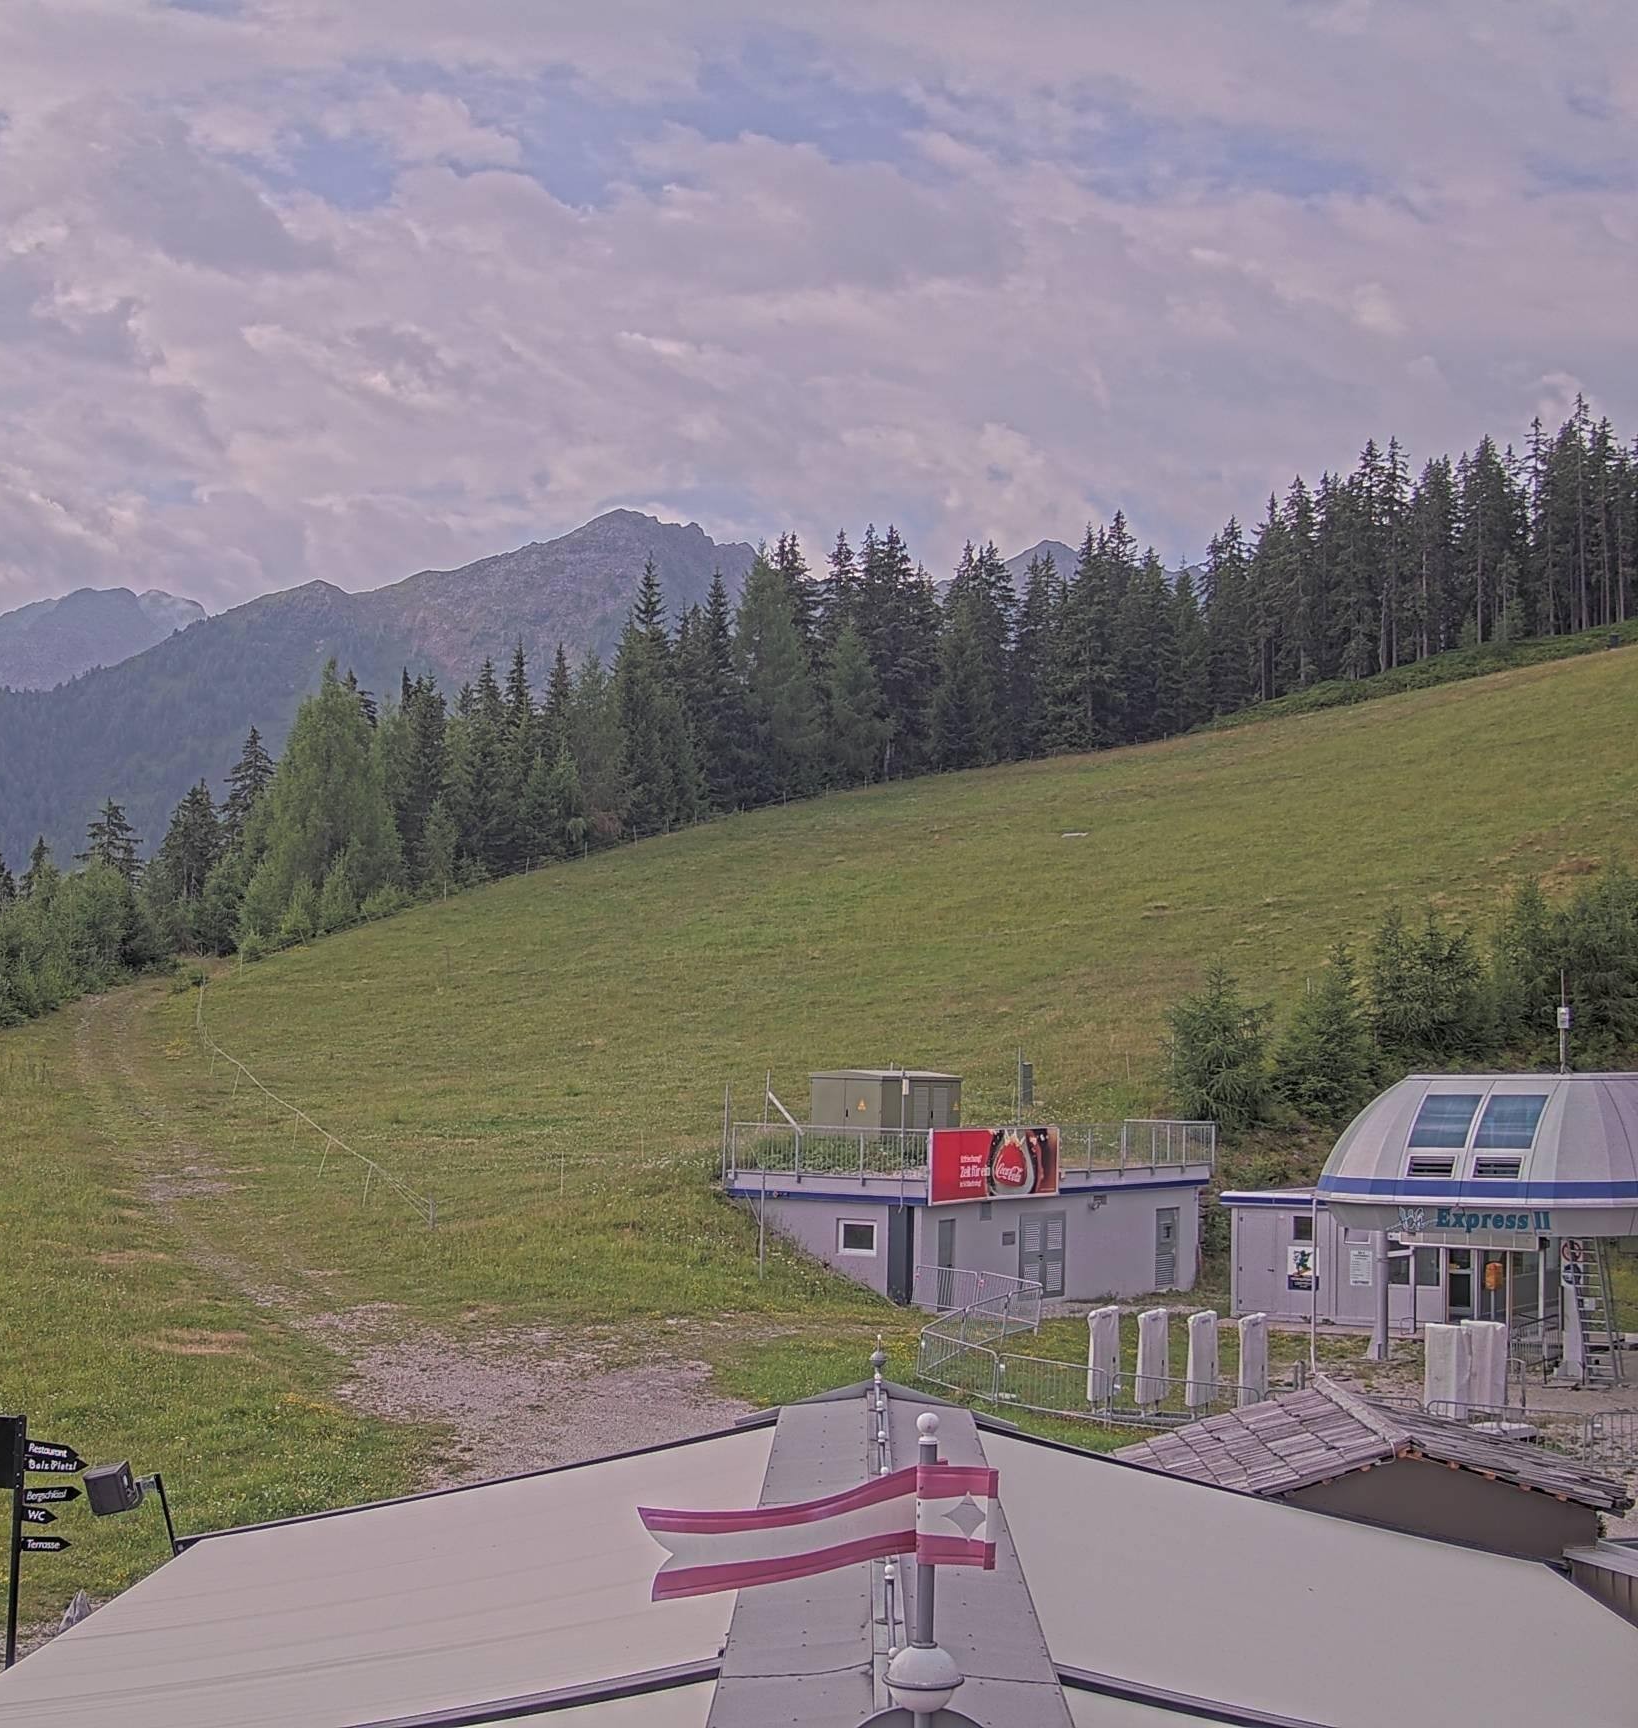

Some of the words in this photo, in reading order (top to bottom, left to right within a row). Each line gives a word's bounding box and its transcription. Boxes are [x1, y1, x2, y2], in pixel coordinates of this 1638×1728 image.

[1436, 1208, 1528, 1233] Express
[28, 1443, 67, 1458] Restaurant
[28, 1509, 46, 1521] WC
[26, 1539, 61, 1549] Terrasse
